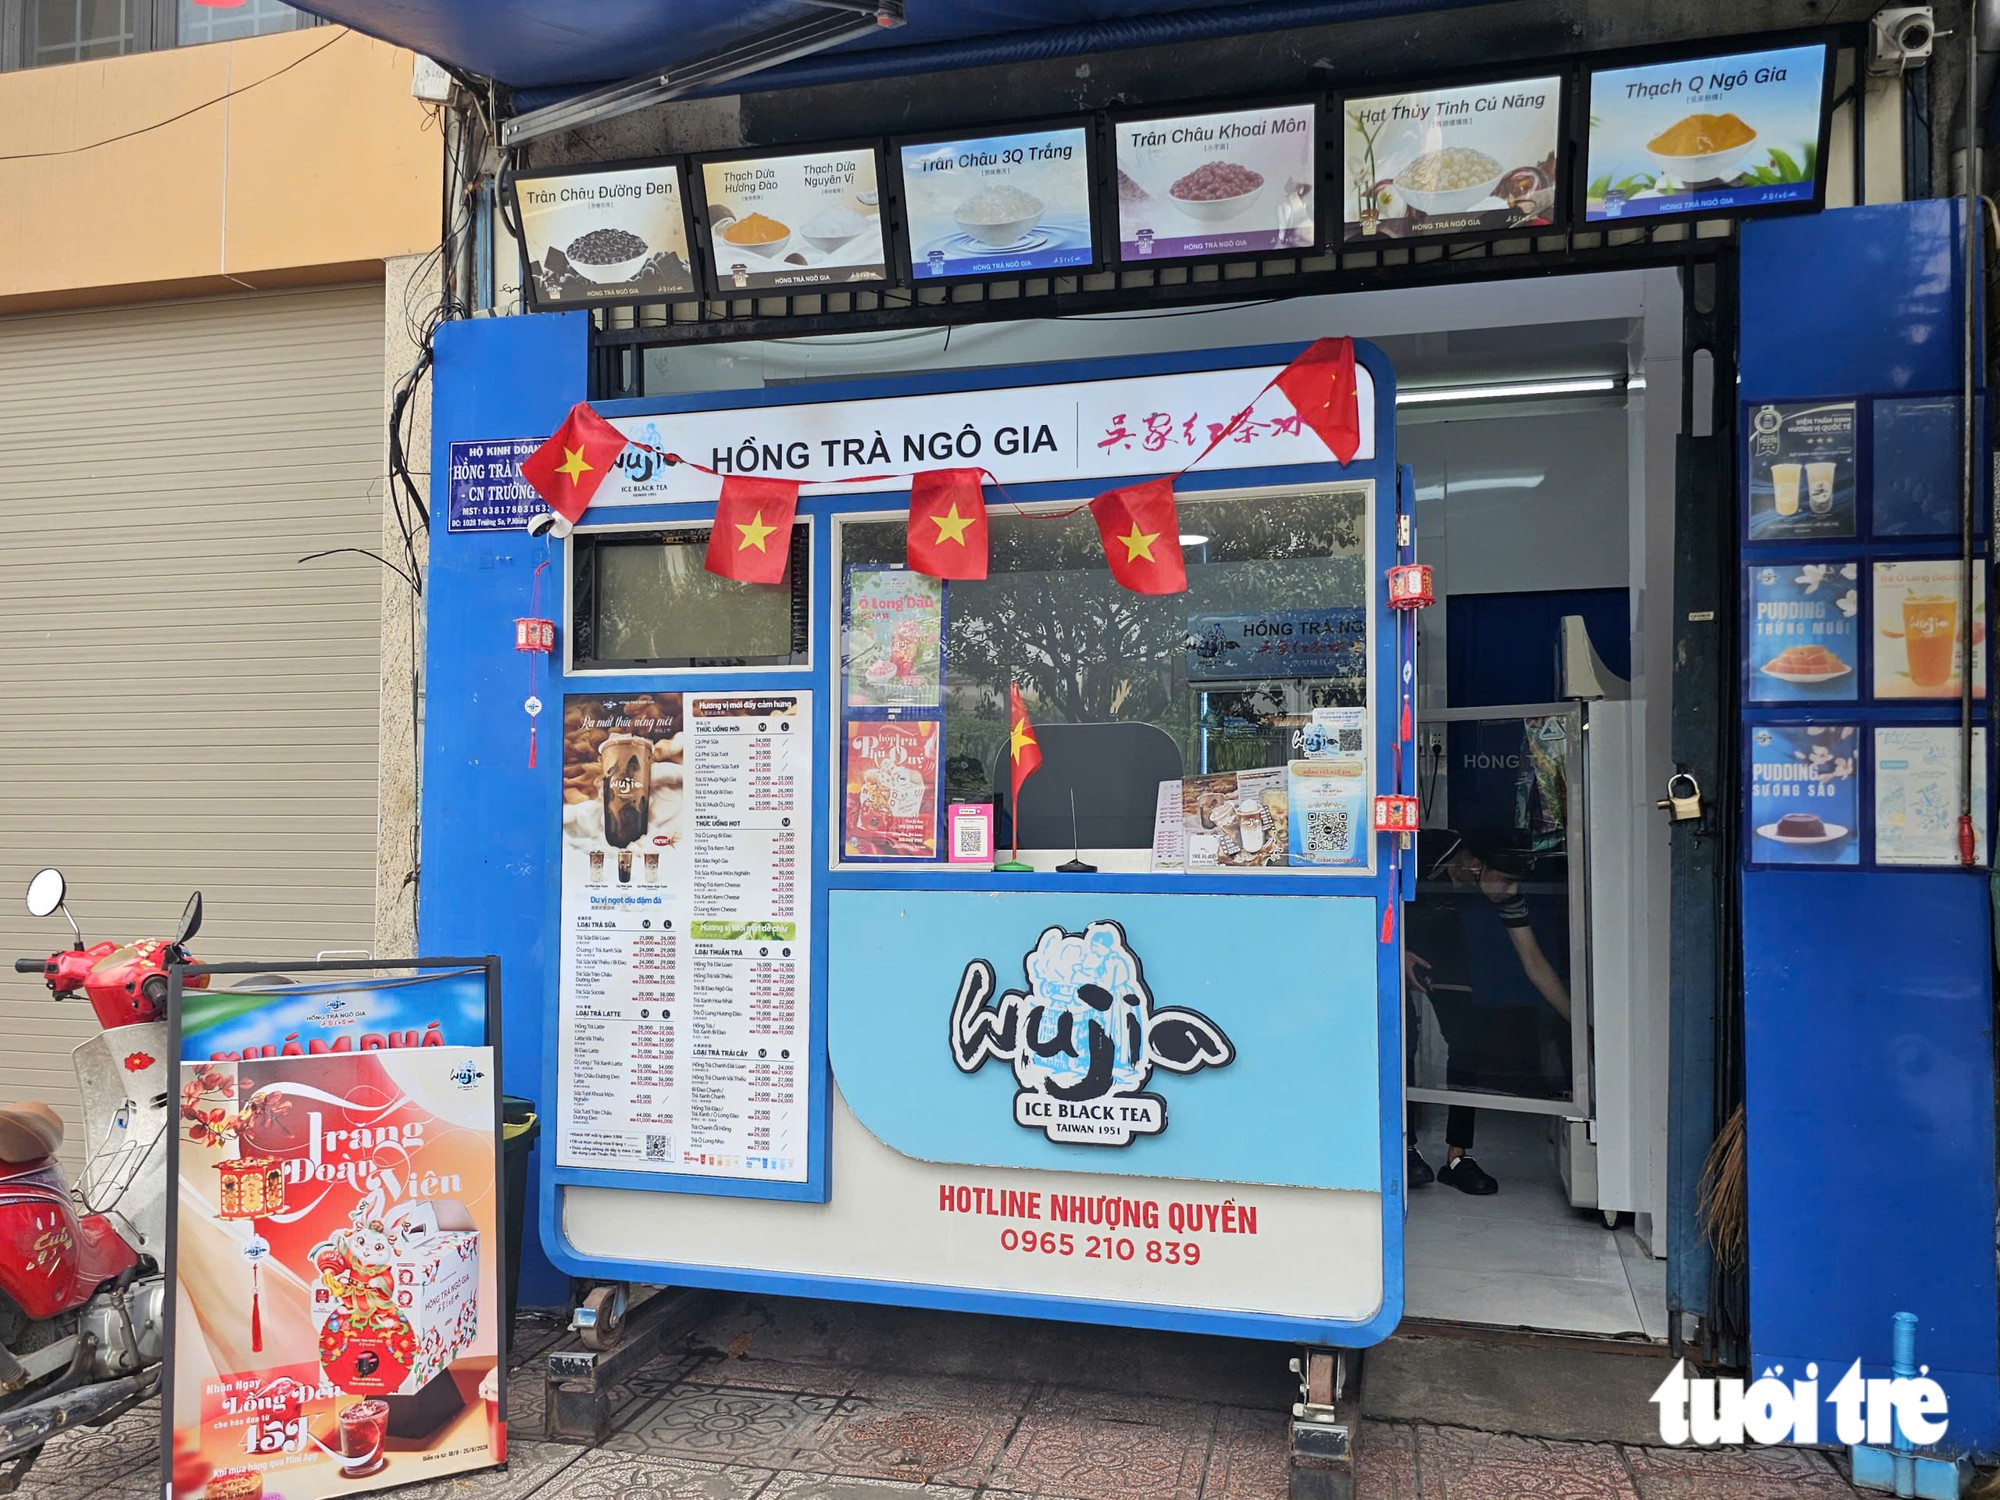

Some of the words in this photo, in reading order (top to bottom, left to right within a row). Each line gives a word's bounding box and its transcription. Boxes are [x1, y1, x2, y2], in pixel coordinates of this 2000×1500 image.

[1626, 78, 1682, 100] Thạch
[1688, 75, 1704, 94] Q
[1709, 70, 1748, 91] Ngô
[1755, 66, 1787, 84] Gia
[1359, 109, 1387, 126] Hạt
[1391, 104, 1430, 121] Thủy
[1474, 95, 1496, 112] Củ
[1502, 94, 1546, 110] Năng
[1131, 130, 1167, 148] Trân
[1172, 126, 1214, 144] Châu
[1219, 120, 1267, 139] Khoai
[1271, 117, 1307, 134] Môn
[921, 157, 954, 172] Trân
[958, 152, 997, 168] Châu
[1002, 148, 1023, 165] 3Q
[1028, 142, 1073, 161] Trắng
[723, 170, 753, 183] Thạch
[755, 169, 775, 179] Dừa
[804, 163, 833, 176] Thạch
[836, 160, 856, 172] Dừa
[725, 181, 756, 195] Hương
[758, 180, 778, 191] Đào
[804, 174, 842, 188] Nguyên
[844, 173, 855, 186] Vị
[527, 190, 556, 204] Trân
[560, 187, 595, 202] Châu
[599, 184, 642, 199] Đường
[646, 182, 672, 195] Đen
[469, 446, 484, 458] HỘ
[486, 445, 511, 456] KINH
[712, 435, 810, 474] HỒNG
[820, 429, 892, 467] TRÀ
[902, 423, 983, 463] NGÔ
[993, 424, 1058, 455] GIA
[453, 456, 486, 480] HỒNG
[488, 458, 513, 478] TRÀ
[469, 486, 485, 502] CN
[488, 481, 536, 501] TRƯỜNG
[462, 507, 481, 516] MST:
[1757, 601, 1826, 620] PUDDING
[1243, 619, 1293, 637] HỒNG
[1299, 617, 1334, 635] TRÀ
[1757, 620, 1805, 636] TRỨNG
[1752, 763, 1820, 782] PUDDING
[1752, 782, 1801, 797] SƯƠNG
[1807, 782, 1836, 797] SÁO
[955, 966, 1226, 1102] wujia
[1025, 1102, 1052, 1117] ICE
[1058, 1103, 1113, 1121] BLACK
[1119, 1107, 1152, 1122] TEA
[307, 1107, 426, 1160] Trăng
[1056, 1123, 1094, 1134] TAIWAN
[1098, 1126, 1121, 1135] 1951
[283, 1154, 378, 1185] Đoàn
[367, 1153, 463, 1201] Viên
[939, 1184, 1041, 1220] HOTLINE
[1050, 1193, 1159, 1231] NHƯỢNG
[1168, 1196, 1257, 1235] QUYỀN
[1000, 1228, 1075, 1256] 0965
[1085, 1235, 1135, 1261] 210
[1146, 1240, 1201, 1266] 839
[206, 1382, 233, 1396] Nhận
[235, 1379, 261, 1392] Ngay
[222, 1391, 287, 1415] Lồng
[291, 1381, 342, 1404] Đèn
[214, 1421, 229, 1430] cho
[213, 1468, 227, 1478] Khi
[228, 1465, 247, 1475] mua
[269, 1459, 285, 1469] qua
[286, 1454, 302, 1464] Mini
[303, 1452, 319, 1462] App
